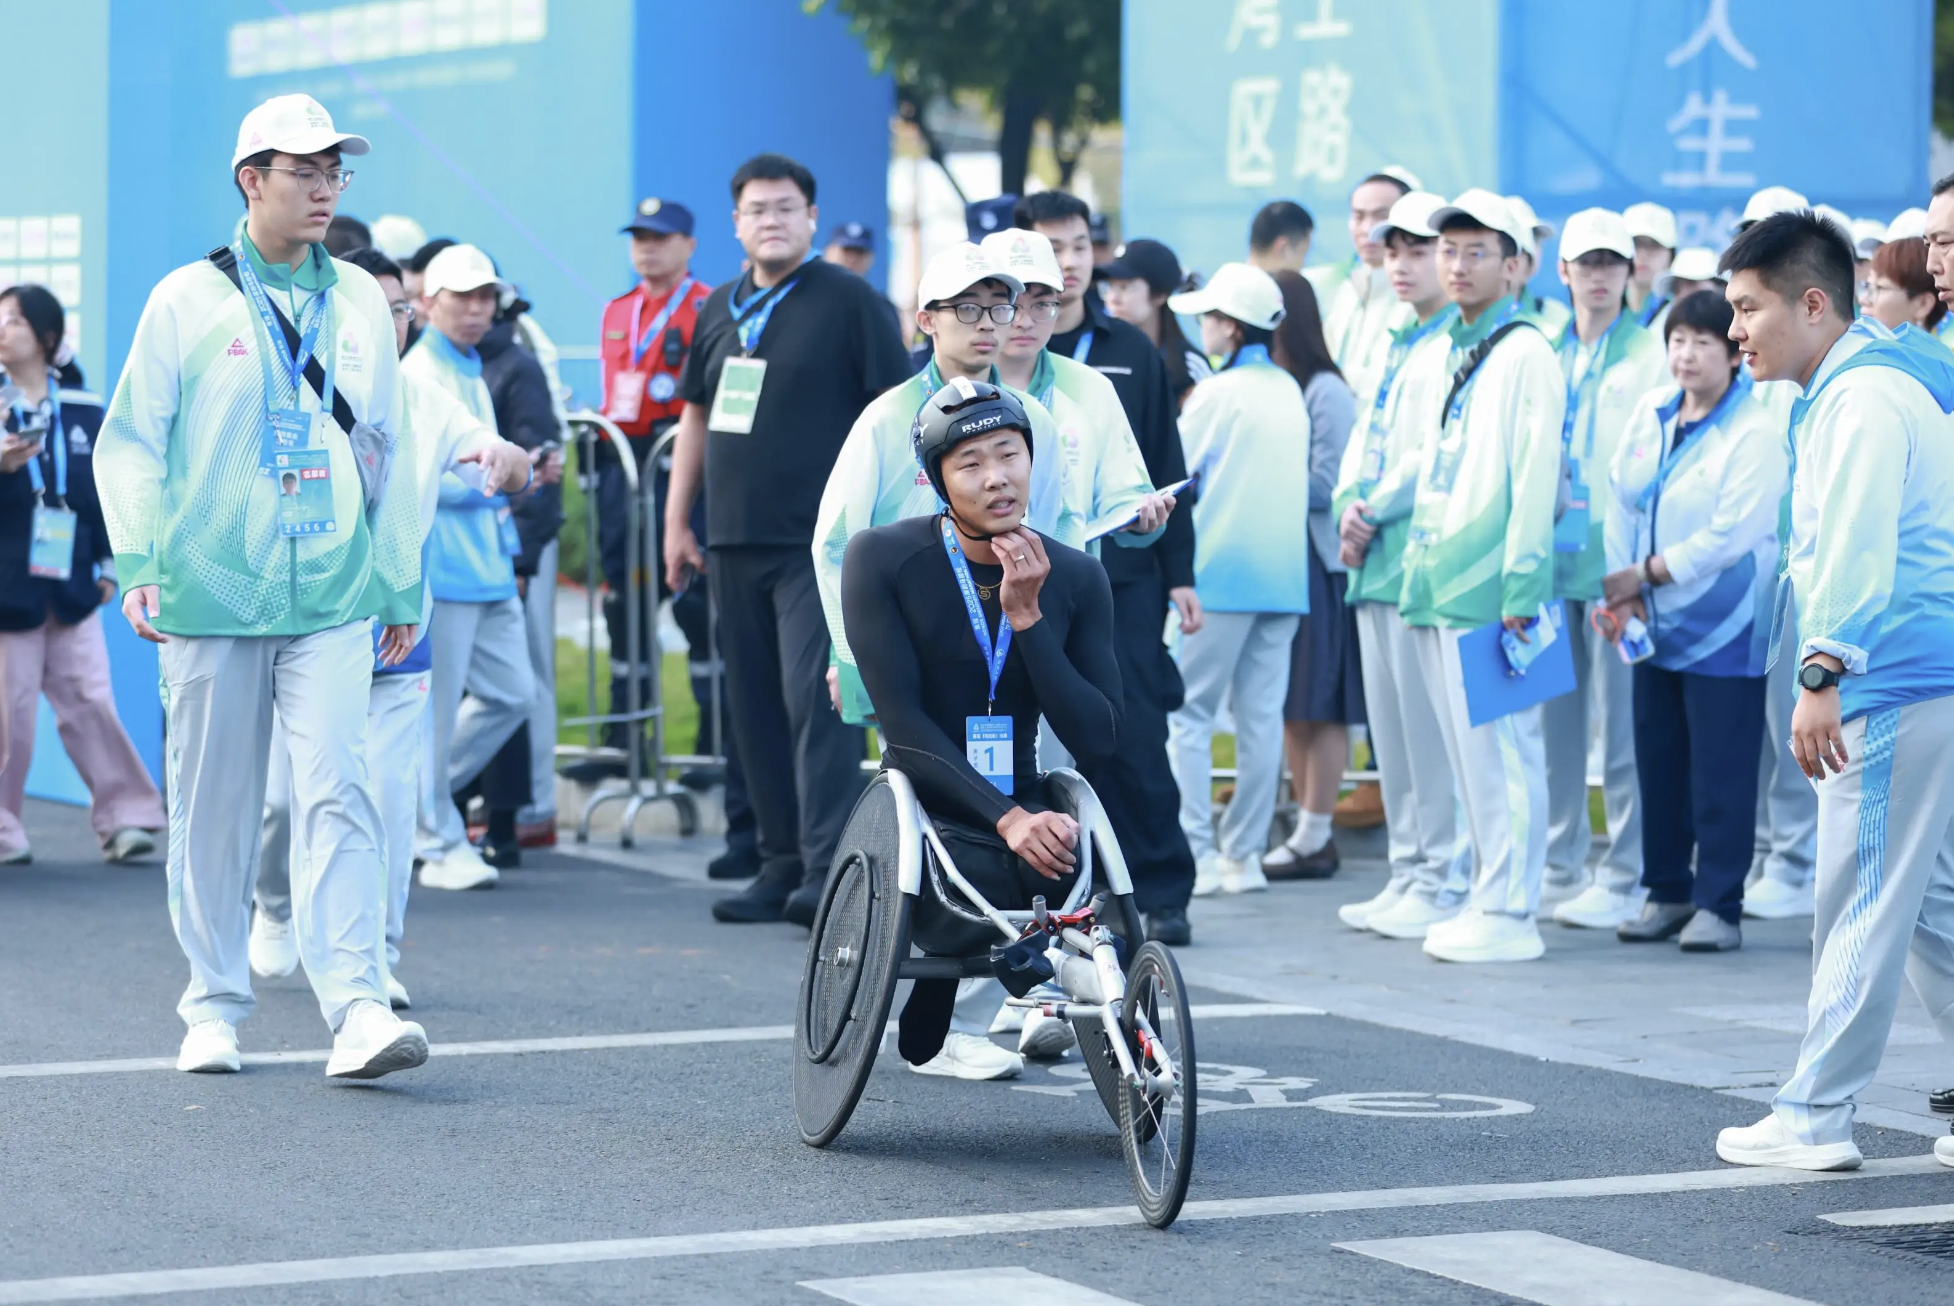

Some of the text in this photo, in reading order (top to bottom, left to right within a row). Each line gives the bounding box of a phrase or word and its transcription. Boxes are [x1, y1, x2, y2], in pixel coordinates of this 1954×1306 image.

[227, 349, 248, 357] PEAK
[961, 415, 1002, 433] RUDY
[285, 523, 320, 534] 2456
[984, 745, 995, 772] 1
